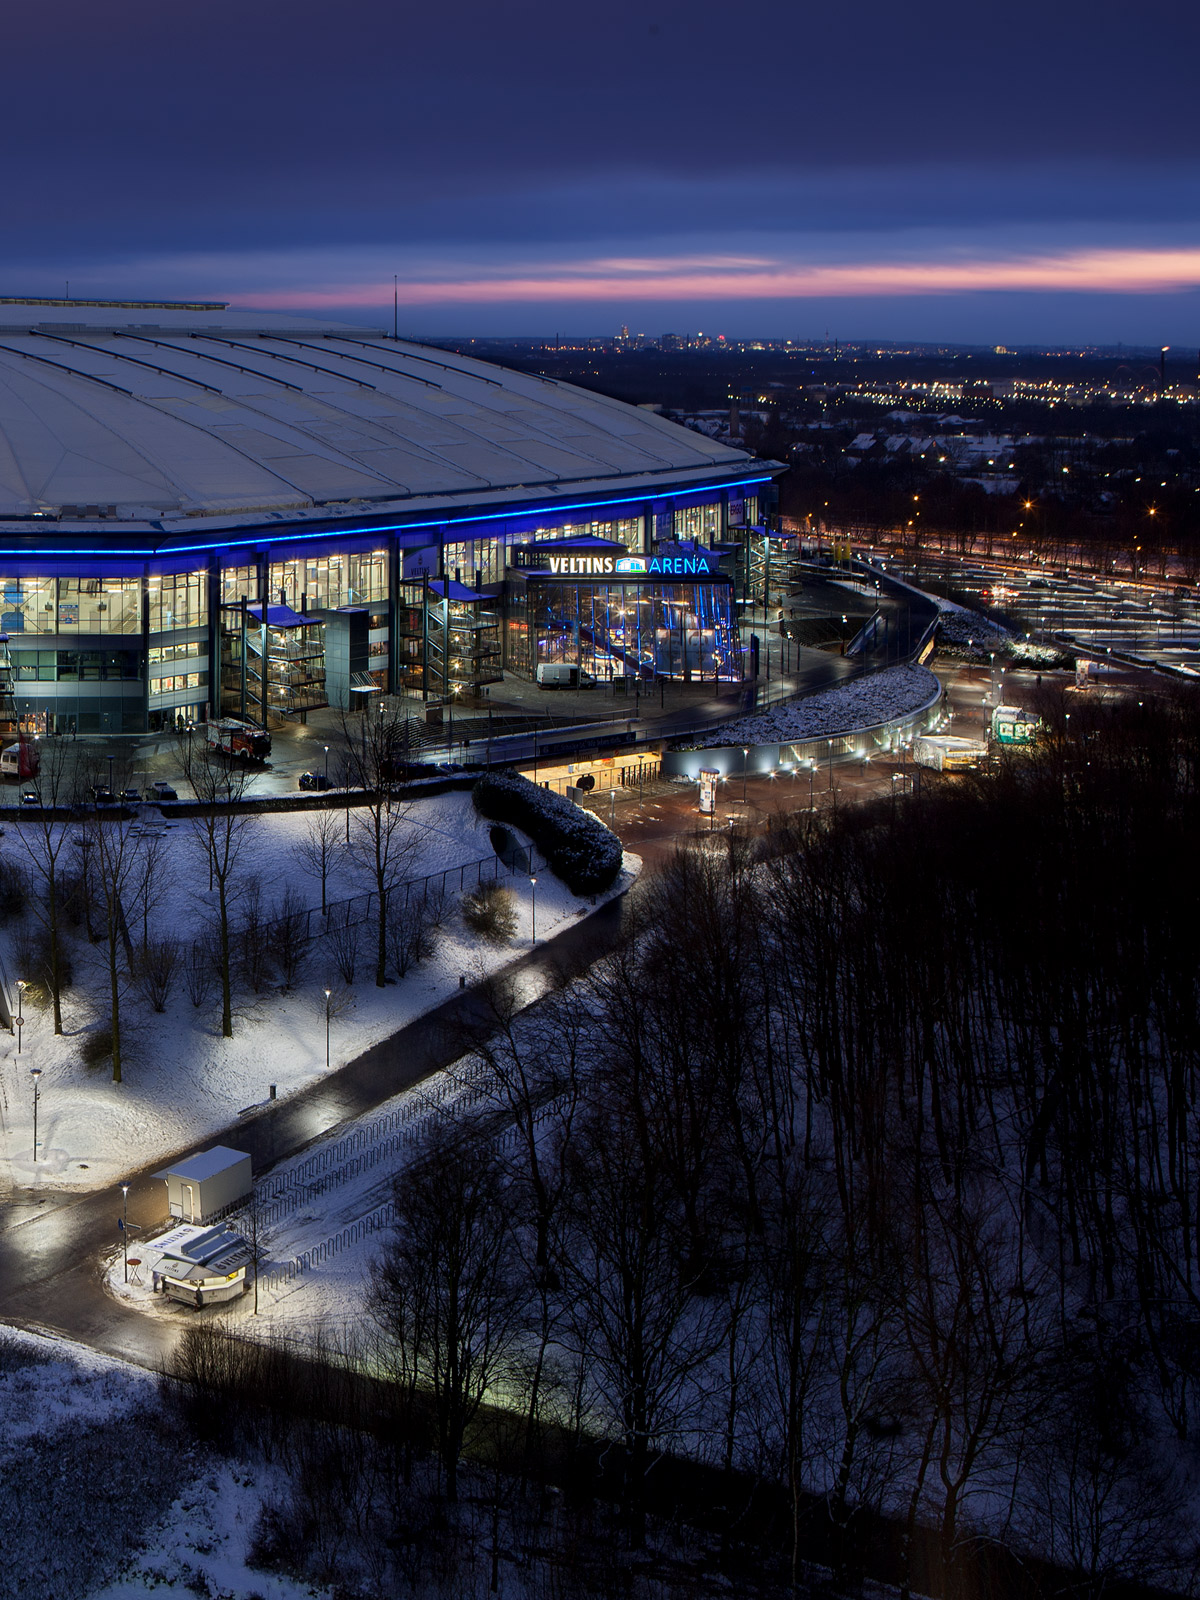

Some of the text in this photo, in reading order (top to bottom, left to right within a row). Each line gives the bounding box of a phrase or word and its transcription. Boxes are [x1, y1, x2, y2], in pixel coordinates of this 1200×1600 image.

[730, 504, 743, 516] ERGO
[549, 556, 710, 574] VELTINS ARENA
[154, 1231, 188, 1249] VELTINS
